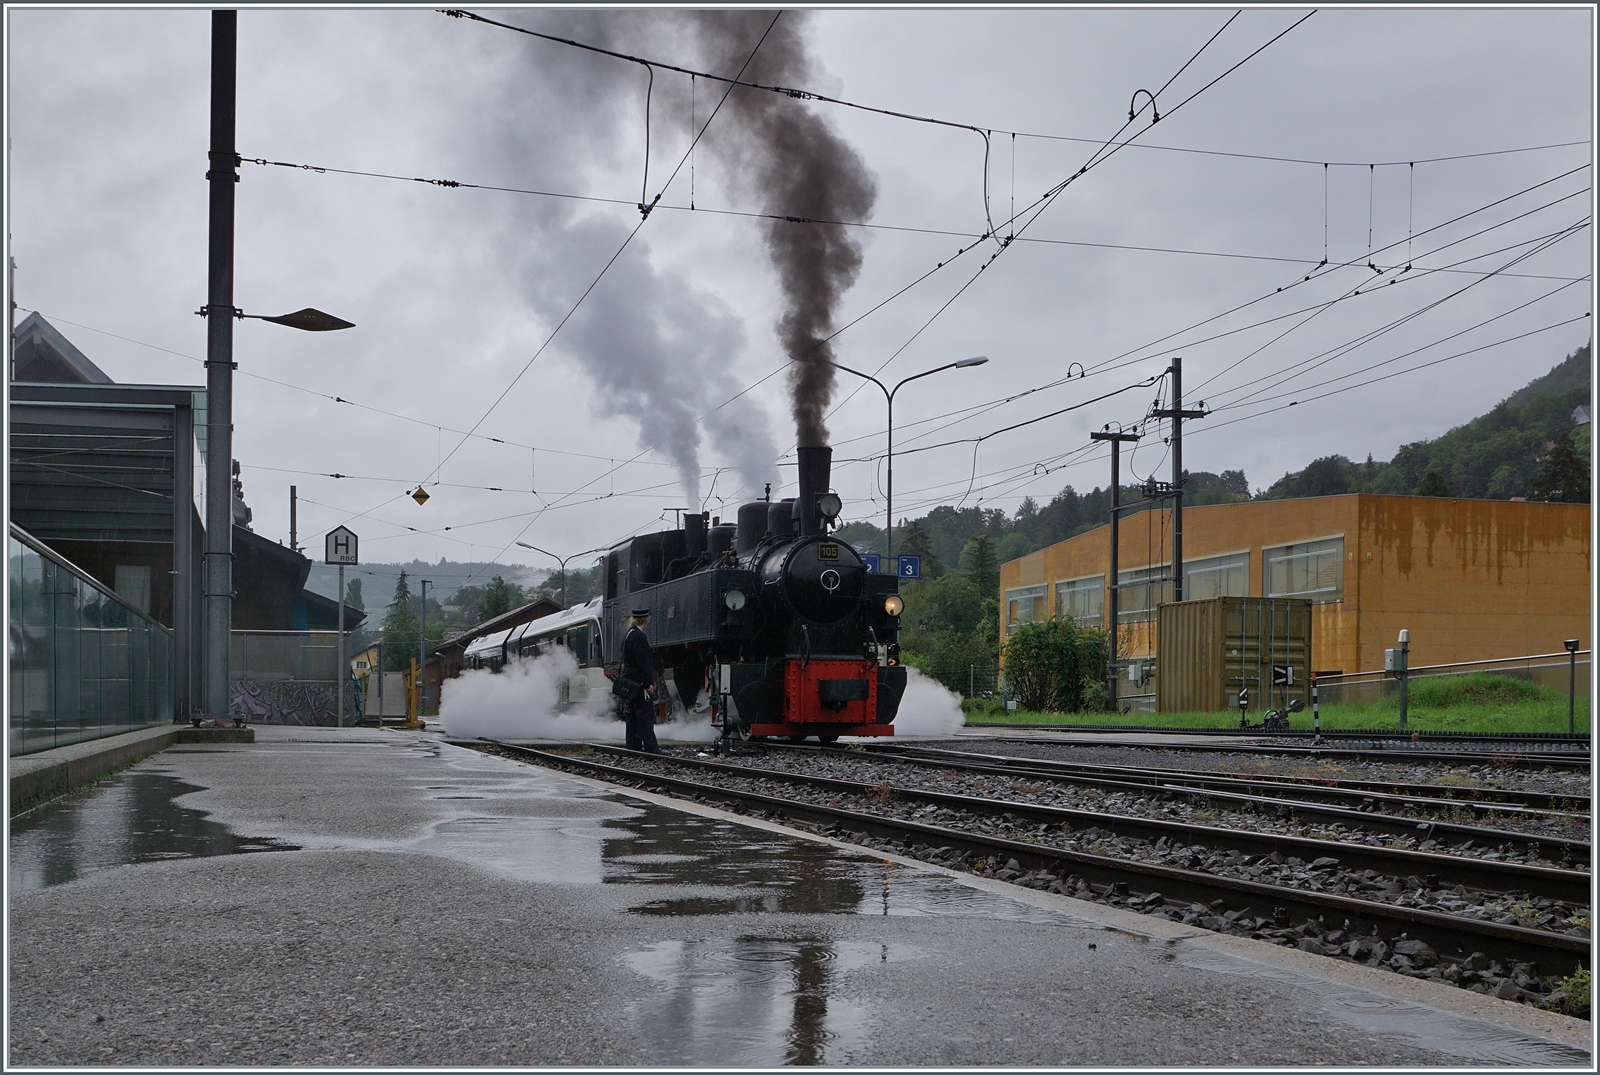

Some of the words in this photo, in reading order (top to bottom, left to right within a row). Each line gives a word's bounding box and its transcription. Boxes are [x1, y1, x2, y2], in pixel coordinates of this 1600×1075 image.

[334, 535, 349, 555] H
[821, 547, 837, 556] 105
[905, 565, 913, 575] 3
